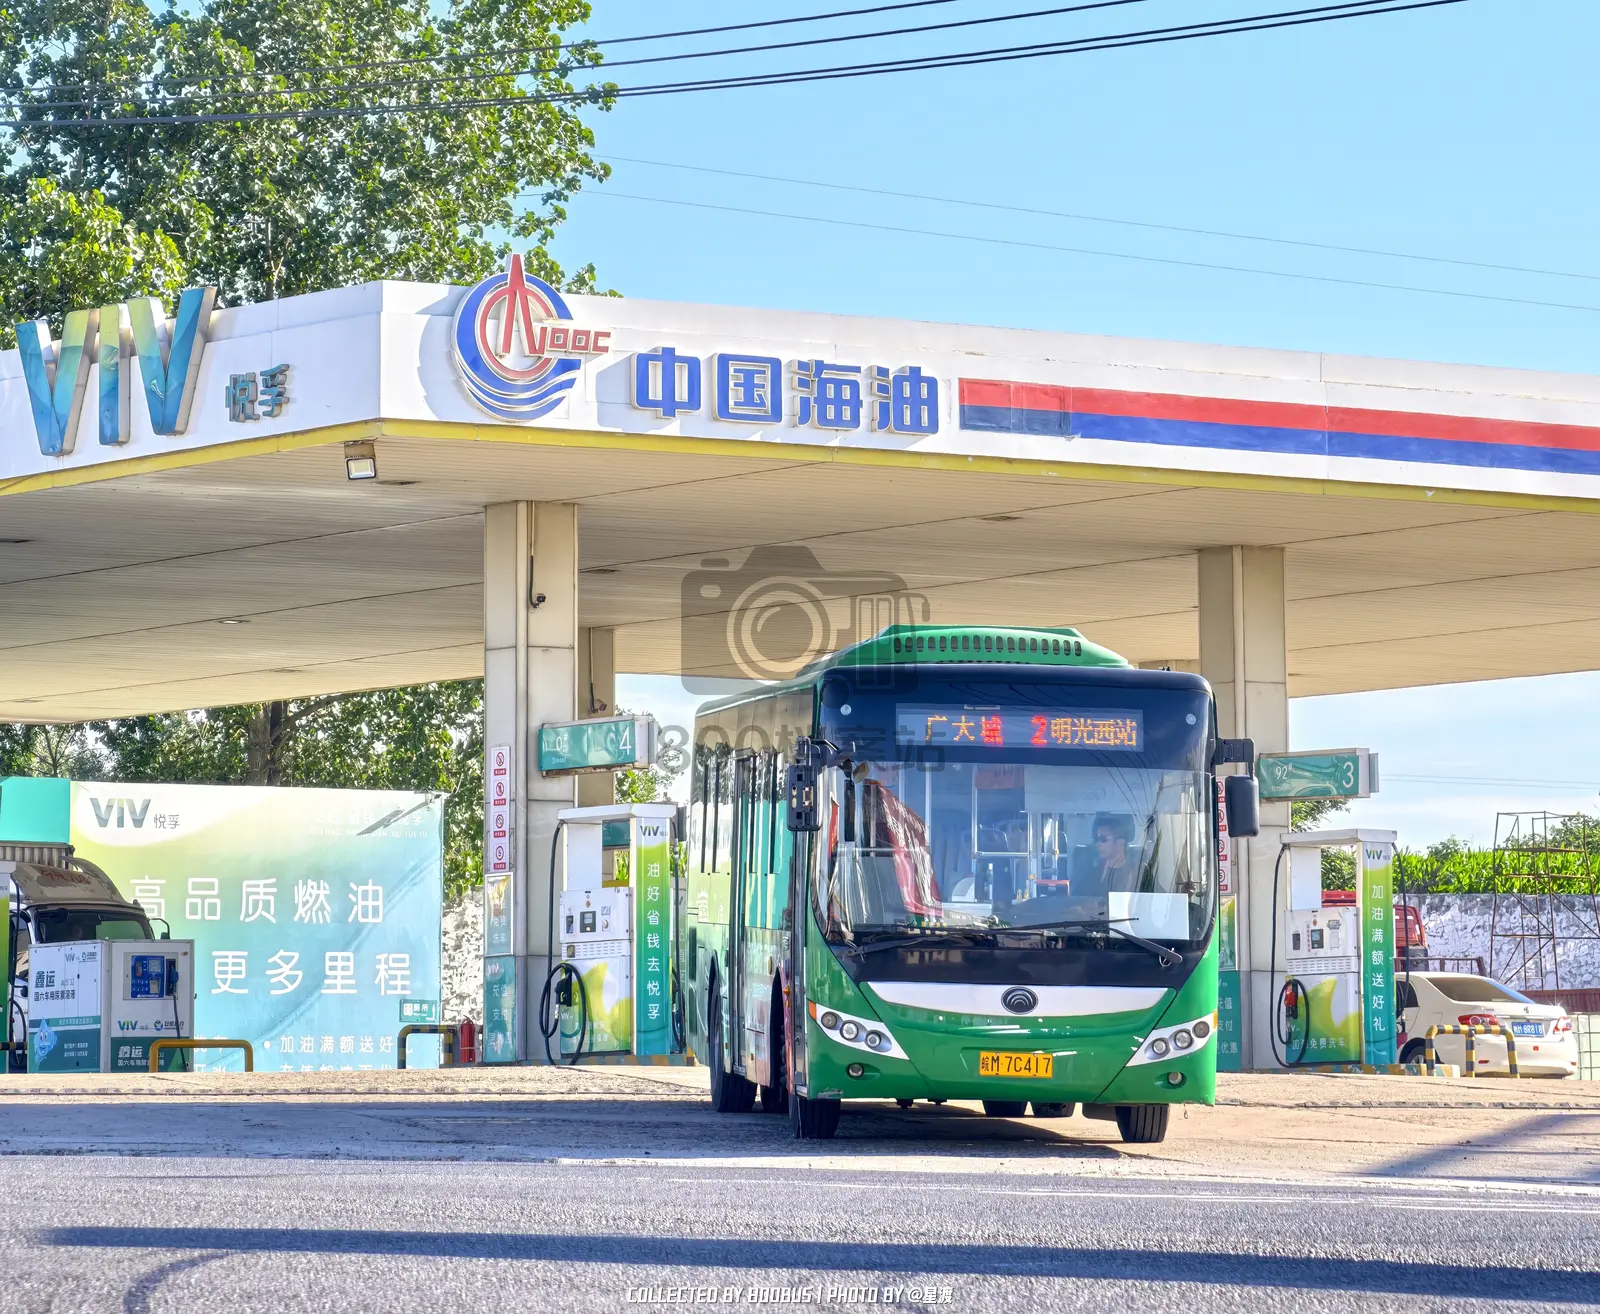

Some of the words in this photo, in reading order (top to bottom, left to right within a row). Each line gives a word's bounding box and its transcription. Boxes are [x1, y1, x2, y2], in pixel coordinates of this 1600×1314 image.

[15, 286, 216, 456] VIV
[225, 363, 290, 423] 悦孚
[631, 346, 939, 434] 中国海油
[619, 726, 632, 755] 4
[1050, 717, 1137, 747] 明光西站
[1342, 761, 1354, 788] 3
[89, 797, 151, 828] VIV
[154, 813, 180, 829] 悦孚
[640, 825, 660, 836] VIV
[1366, 849, 1382, 860] VIV
[129, 874, 385, 924] 高品质燃油
[646, 863, 661, 1020] 油好省钱去悦孚
[210, 949, 412, 996] 更多里程
[1371, 884, 1386, 1032] 加油满额送好礼
[118, 1020, 138, 1031] VIV
[280, 1035, 413, 1053] 加油满额送好
